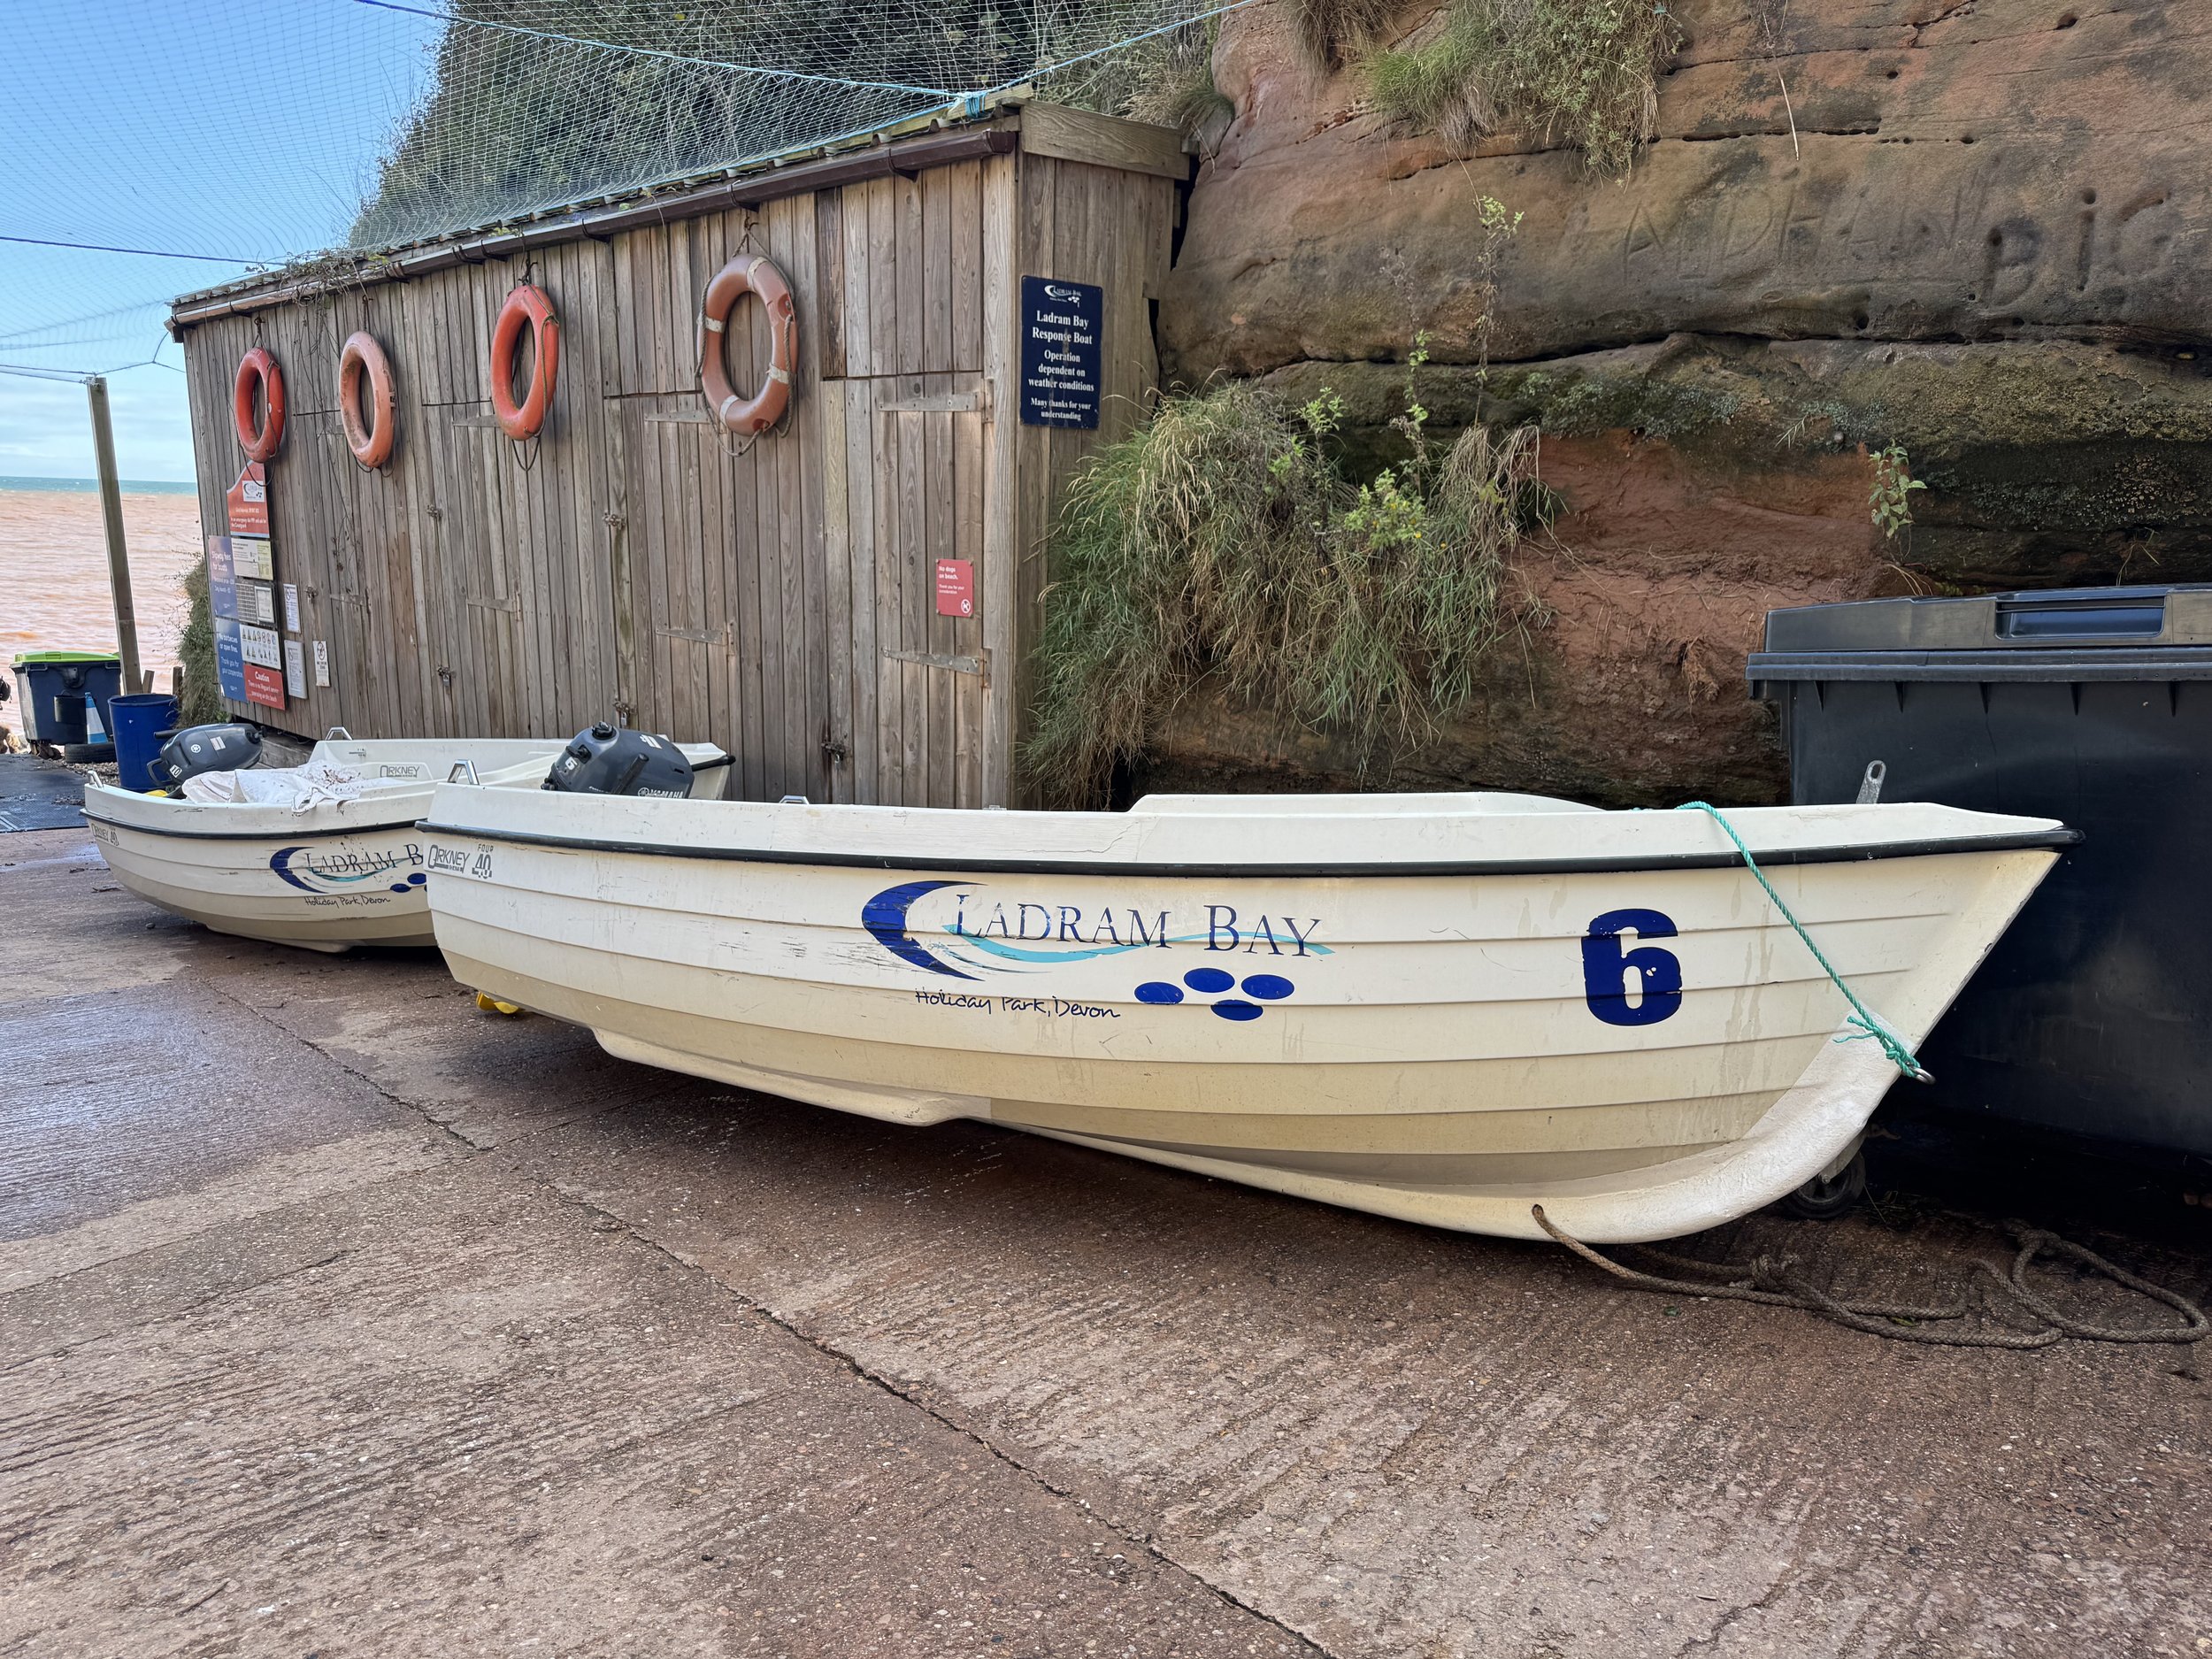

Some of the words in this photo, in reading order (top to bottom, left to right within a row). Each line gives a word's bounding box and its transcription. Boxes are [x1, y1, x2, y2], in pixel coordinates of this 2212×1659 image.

[1036, 310, 1071, 326] Ladram
[1073, 315, 1089, 330] Bay
[1032, 326, 1071, 343] Response
[1073, 332, 1093, 345] Boat
[1044, 349, 1080, 363] Operation
[1038, 363, 1075, 376] dependent
[1028, 378, 1057, 388] weather
[1058, 380, 1094, 392] conditions
[1031, 396, 1048, 409] Many
[1048, 399, 1068, 408] thanks
[1041, 411, 1081, 421] understanding
[254, 671, 270, 682] Caution
[171, 766, 180, 776] 10
[304, 851, 397, 873] LADRAM
[427, 844, 471, 873] ORKNEY
[303, 895, 338, 909] Holiday
[362, 894, 390, 904] Devon
[956, 894, 1172, 949] LADRAM
[1203, 904, 1322, 957] BAY
[1580, 908, 1682, 1026] 6
[915, 987, 992, 1014] Holiday
[1052, 995, 1121, 1018] Devon
